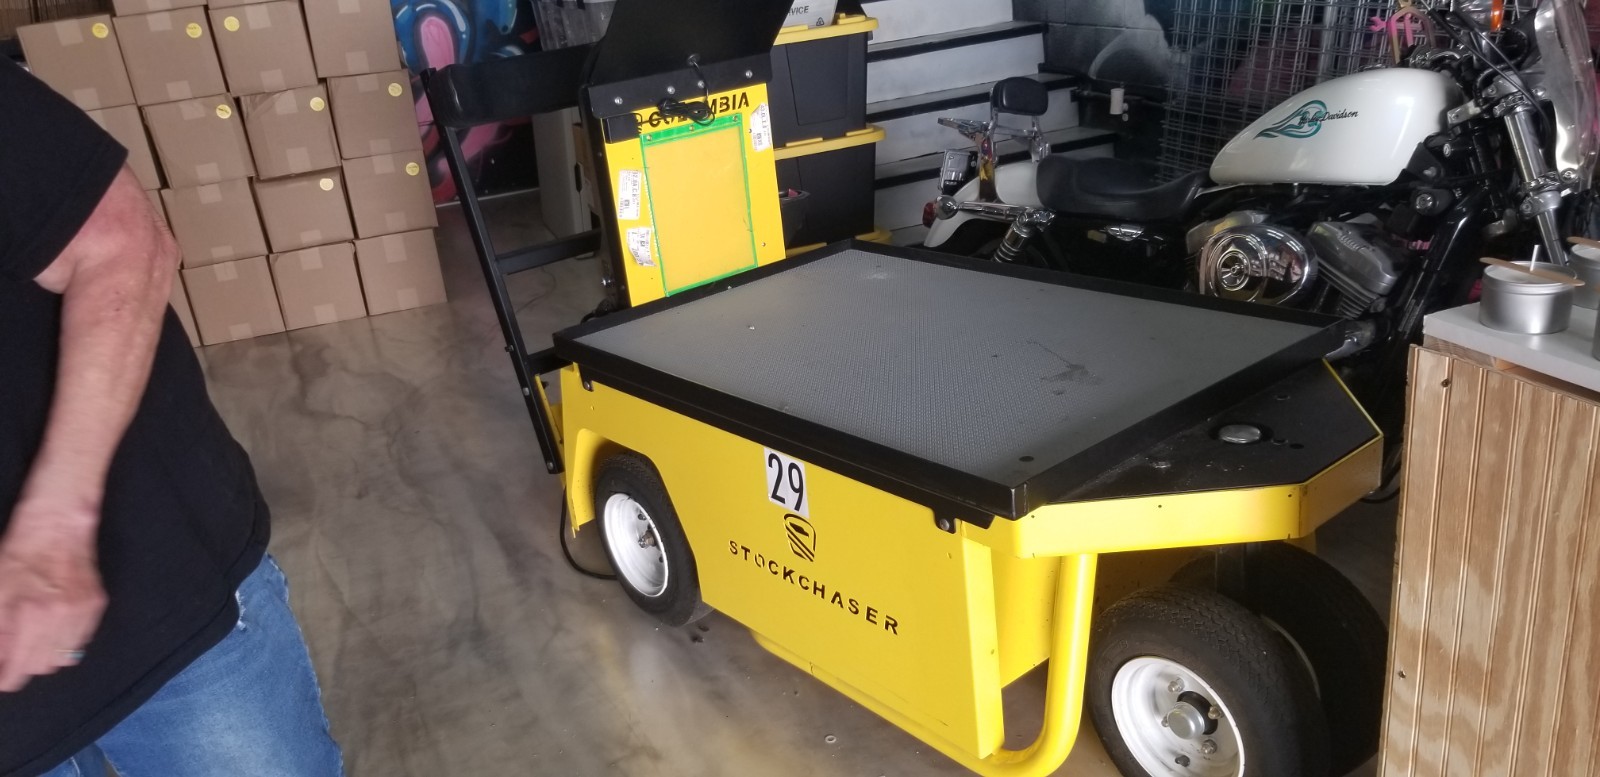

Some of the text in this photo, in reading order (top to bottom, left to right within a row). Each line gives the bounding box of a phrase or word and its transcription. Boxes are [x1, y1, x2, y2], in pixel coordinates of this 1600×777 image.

[648, 92, 750, 127] CMBIA
[767, 452, 805, 512] 29
[728, 540, 899, 635] STOCKCHASER
